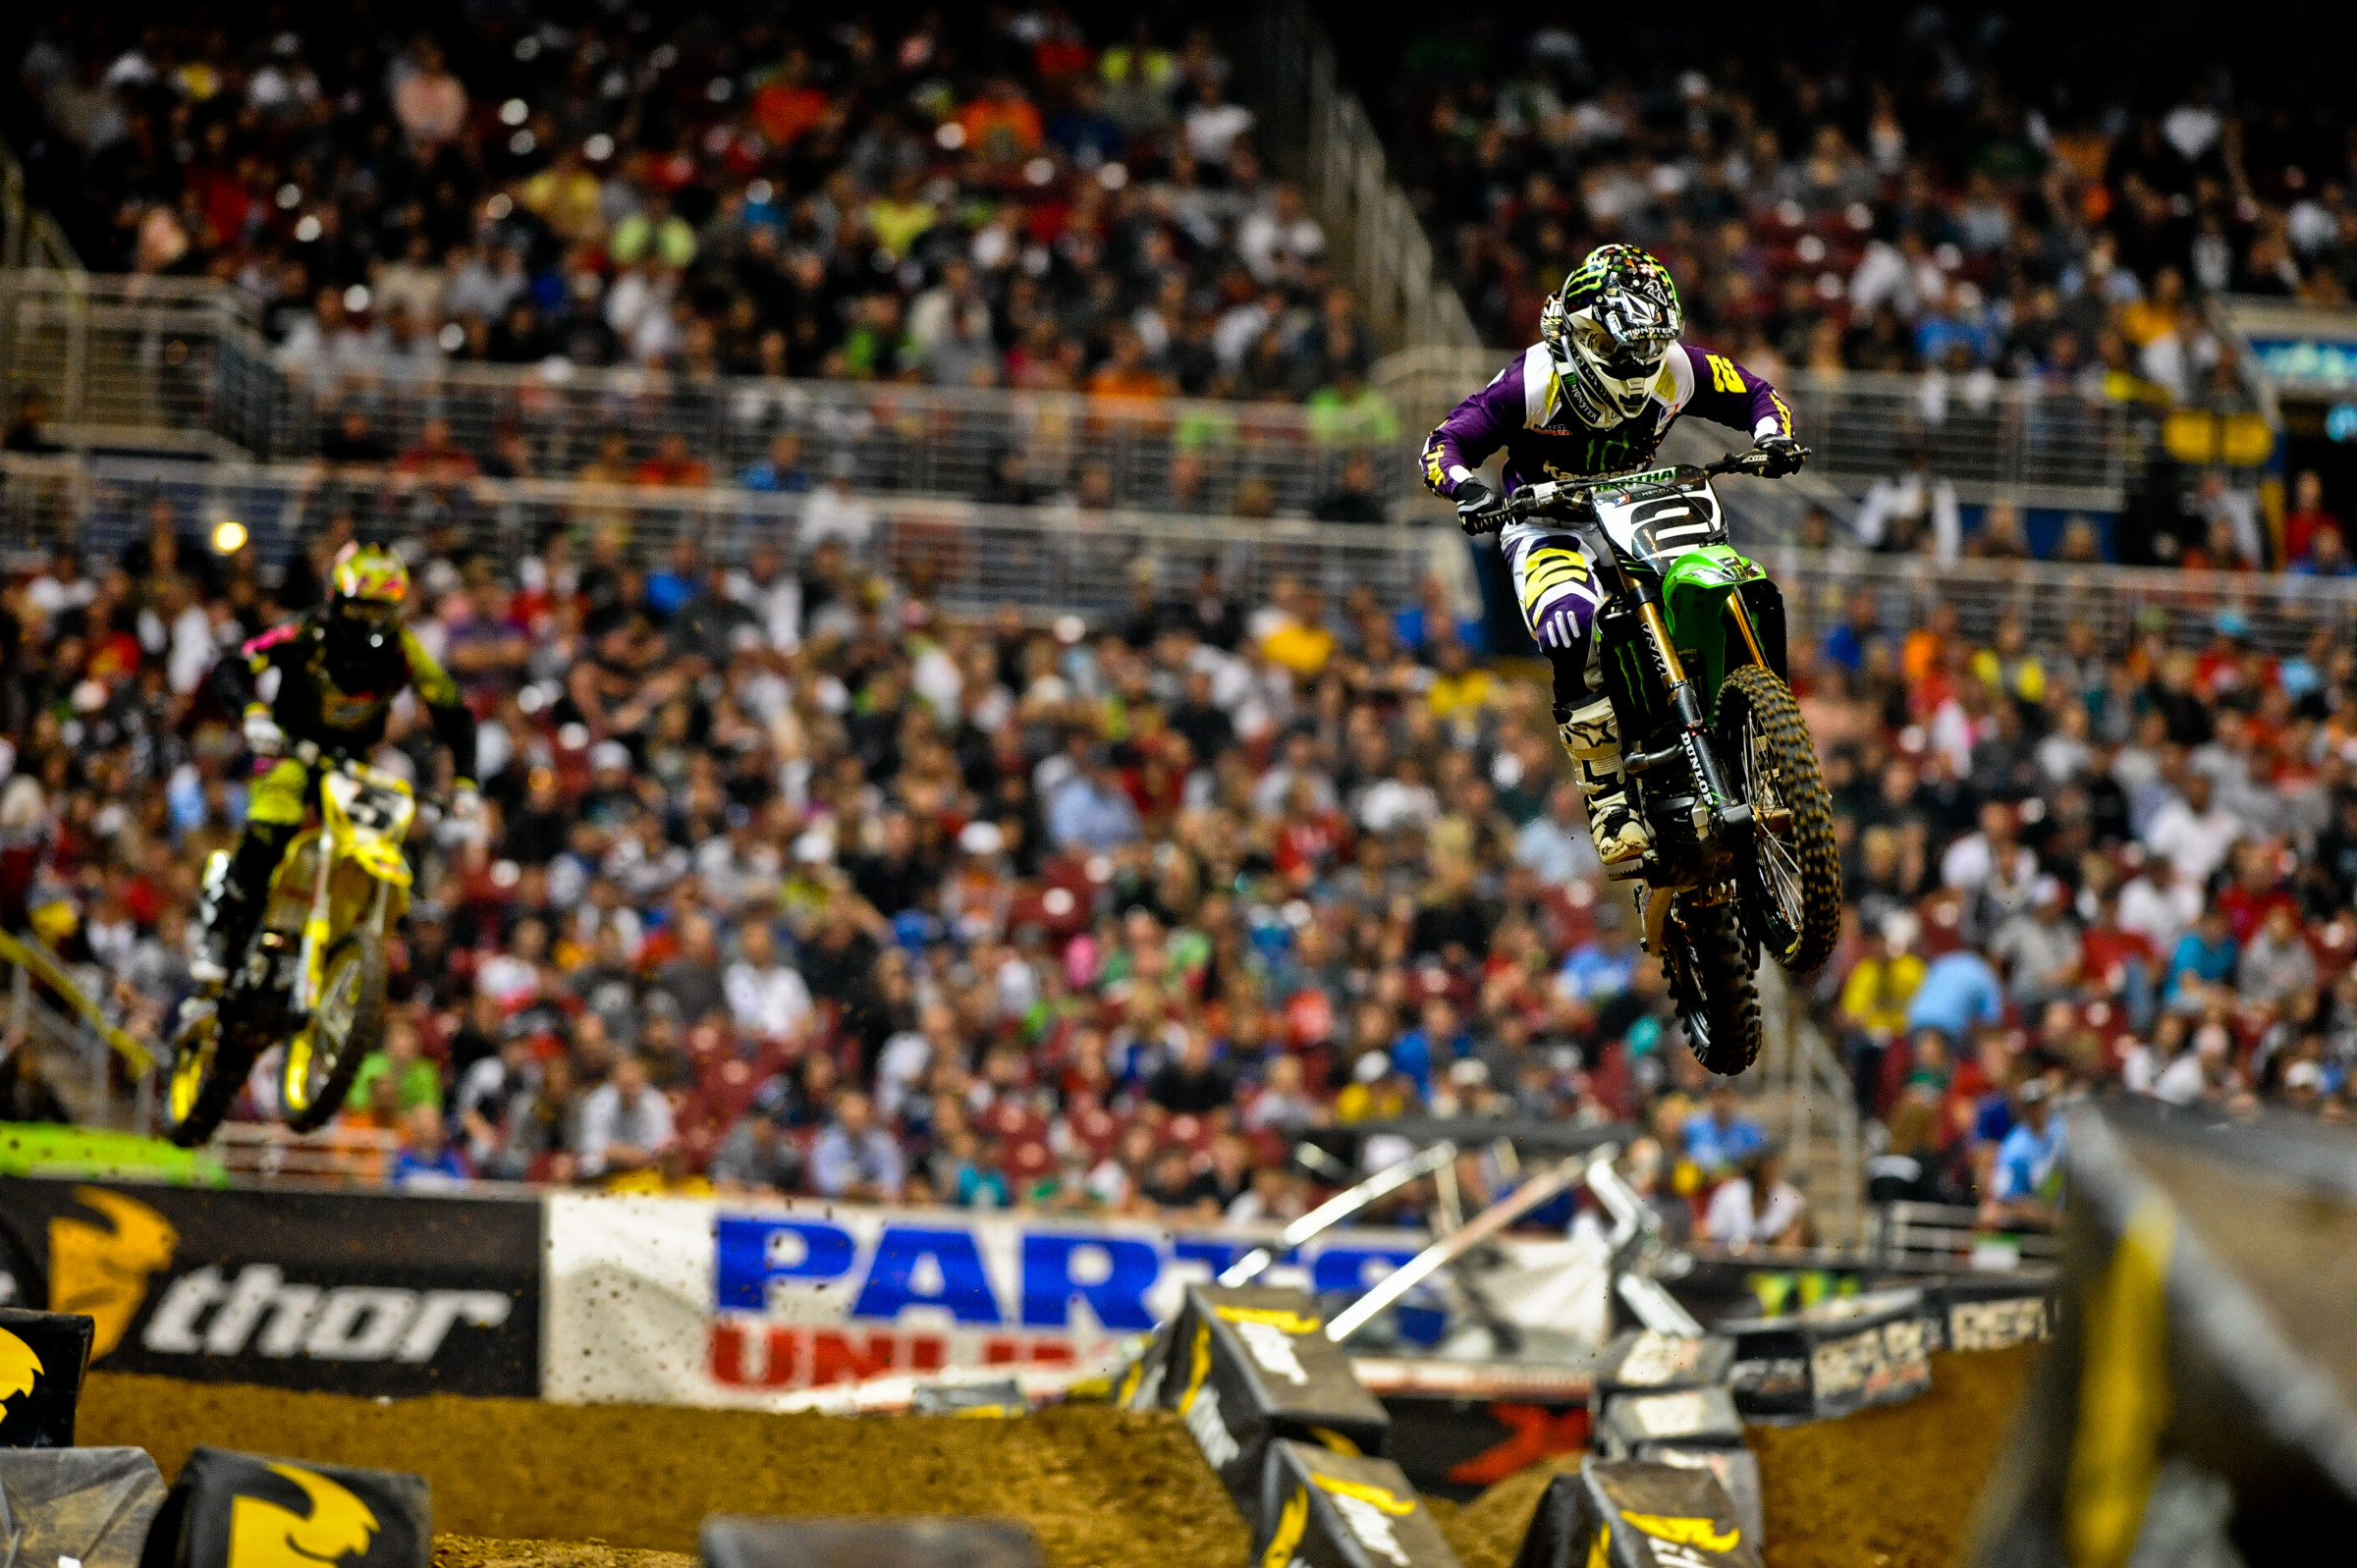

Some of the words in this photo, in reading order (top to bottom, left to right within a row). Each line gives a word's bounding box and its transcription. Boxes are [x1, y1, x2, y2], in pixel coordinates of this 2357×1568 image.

[1570, 384, 1598, 422] MONSTER
[1630, 496, 1715, 561] 2
[1680, 730, 1714, 806] DUNLOP
[142, 1263, 513, 1363] thor
